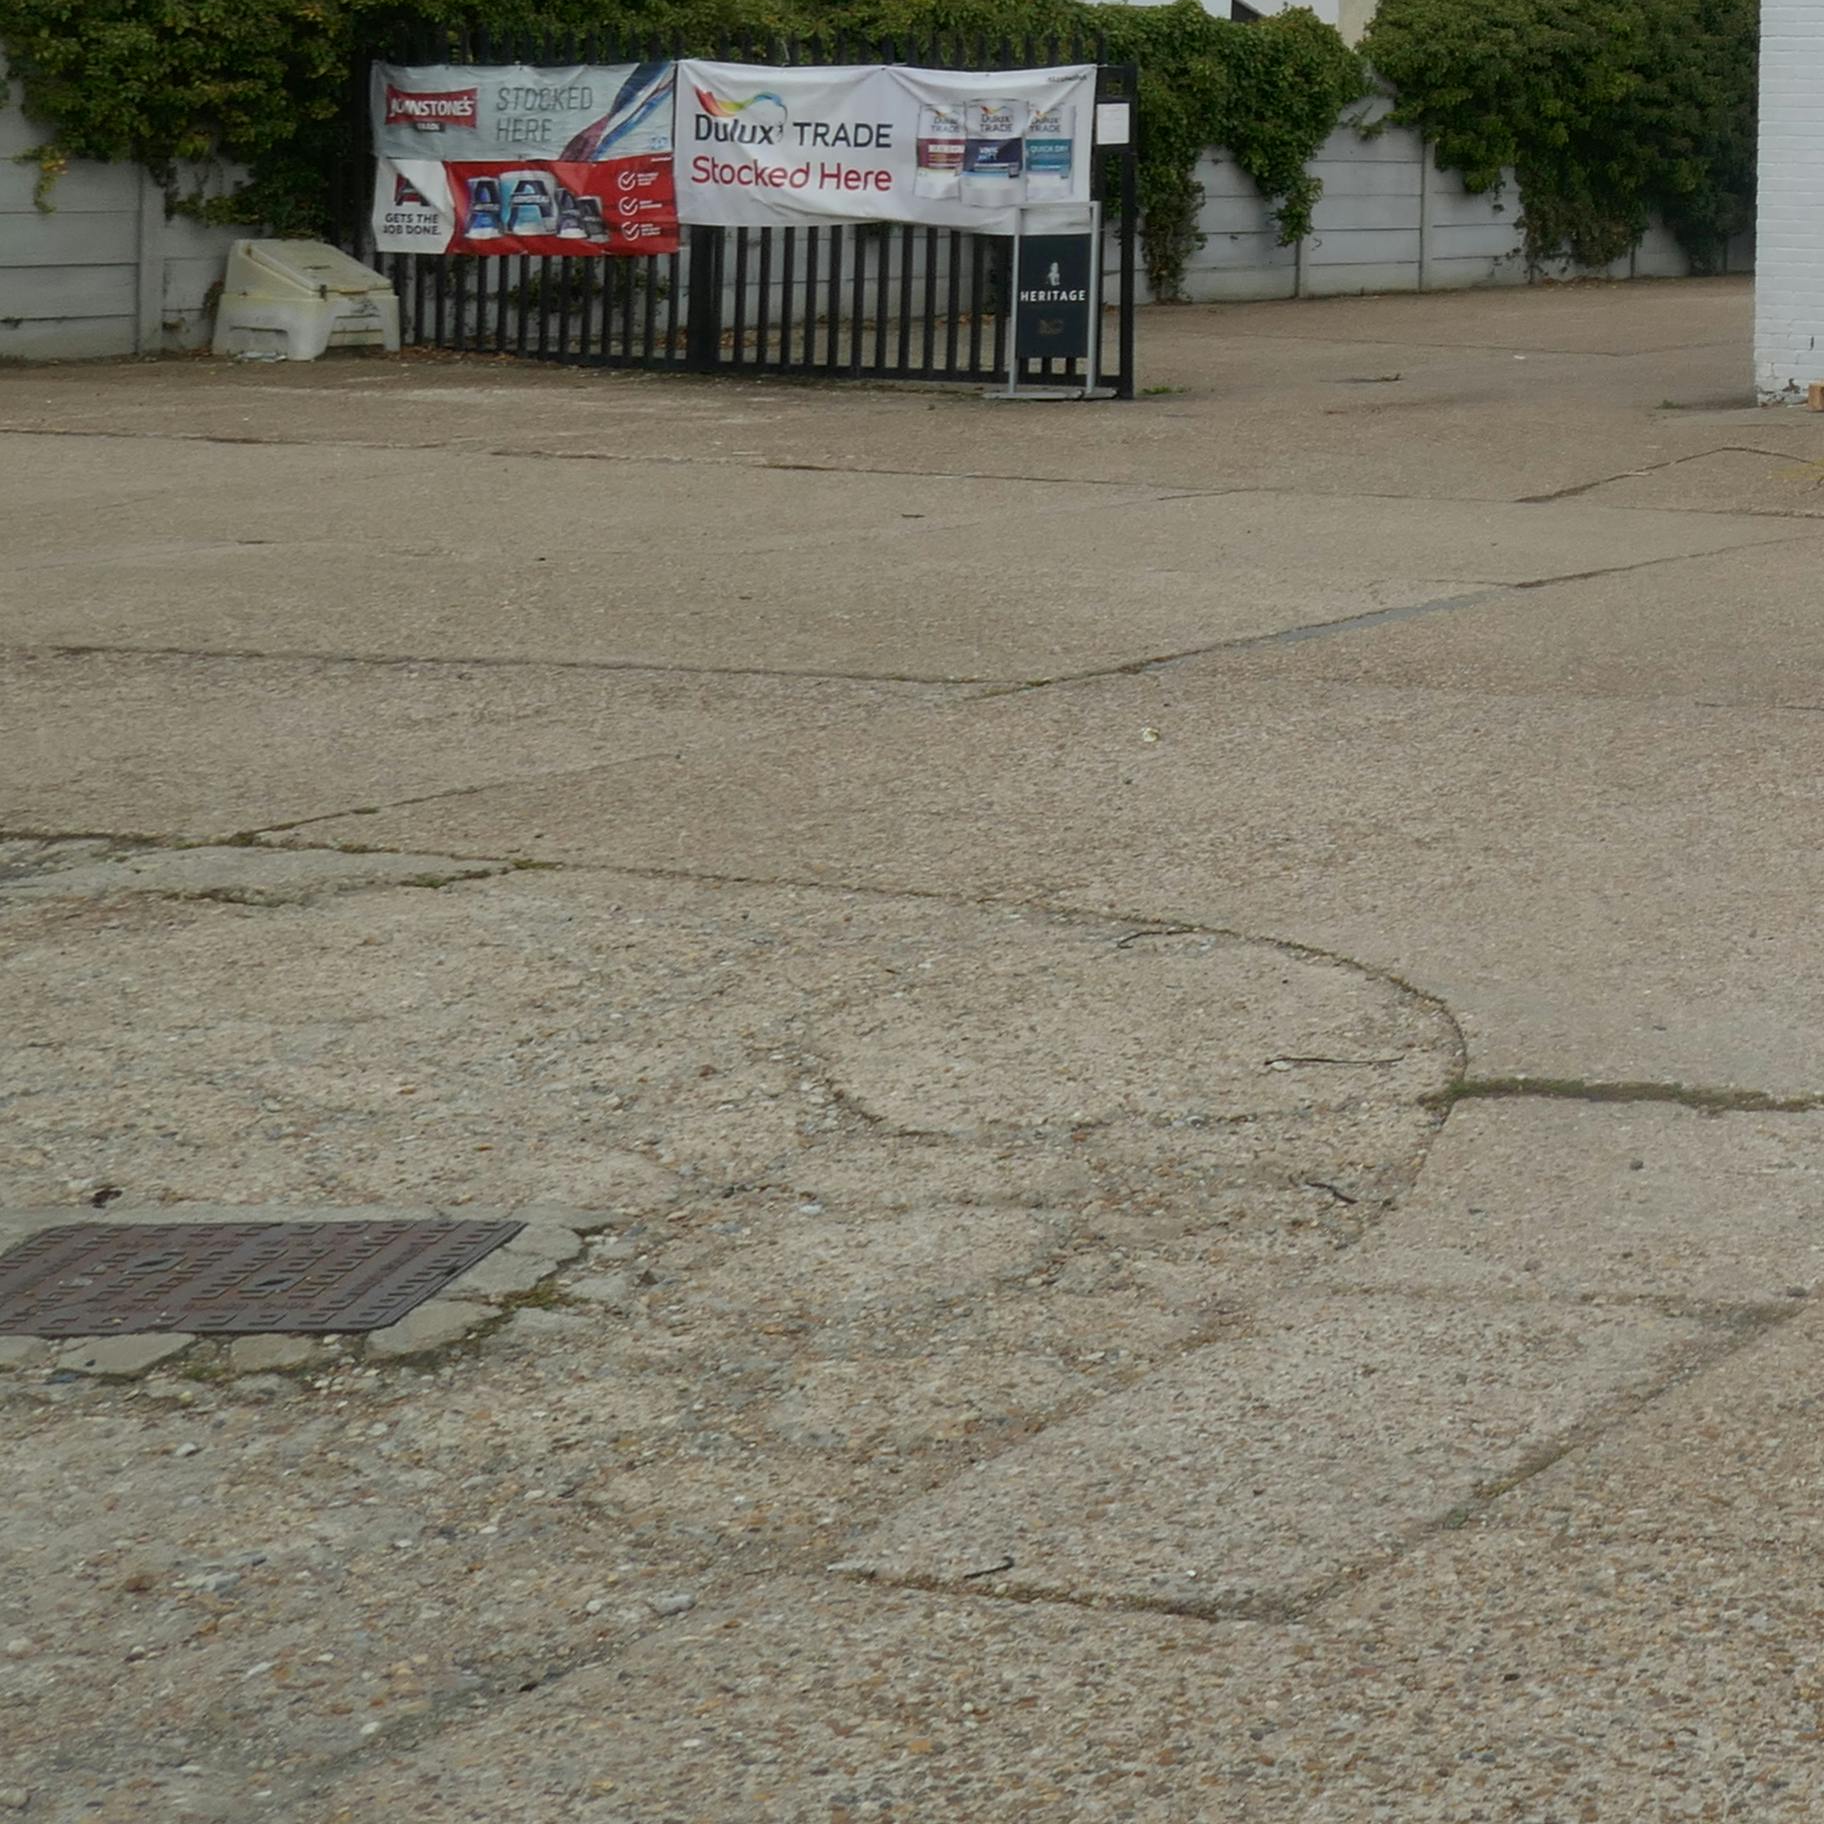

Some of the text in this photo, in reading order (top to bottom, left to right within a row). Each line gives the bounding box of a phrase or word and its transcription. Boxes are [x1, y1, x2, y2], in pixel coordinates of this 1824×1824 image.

[496, 86, 593, 112] STOCKED
[496, 118, 553, 143] HERE
[695, 113, 894, 148] Dulux TRADE
[691, 155, 810, 189] Stocked
[819, 161, 893, 191] Here
[384, 225, 442, 235] JOB DONE.
[385, 213, 439, 224] GETS THE
[1020, 290, 1086, 301] HERITAGE
